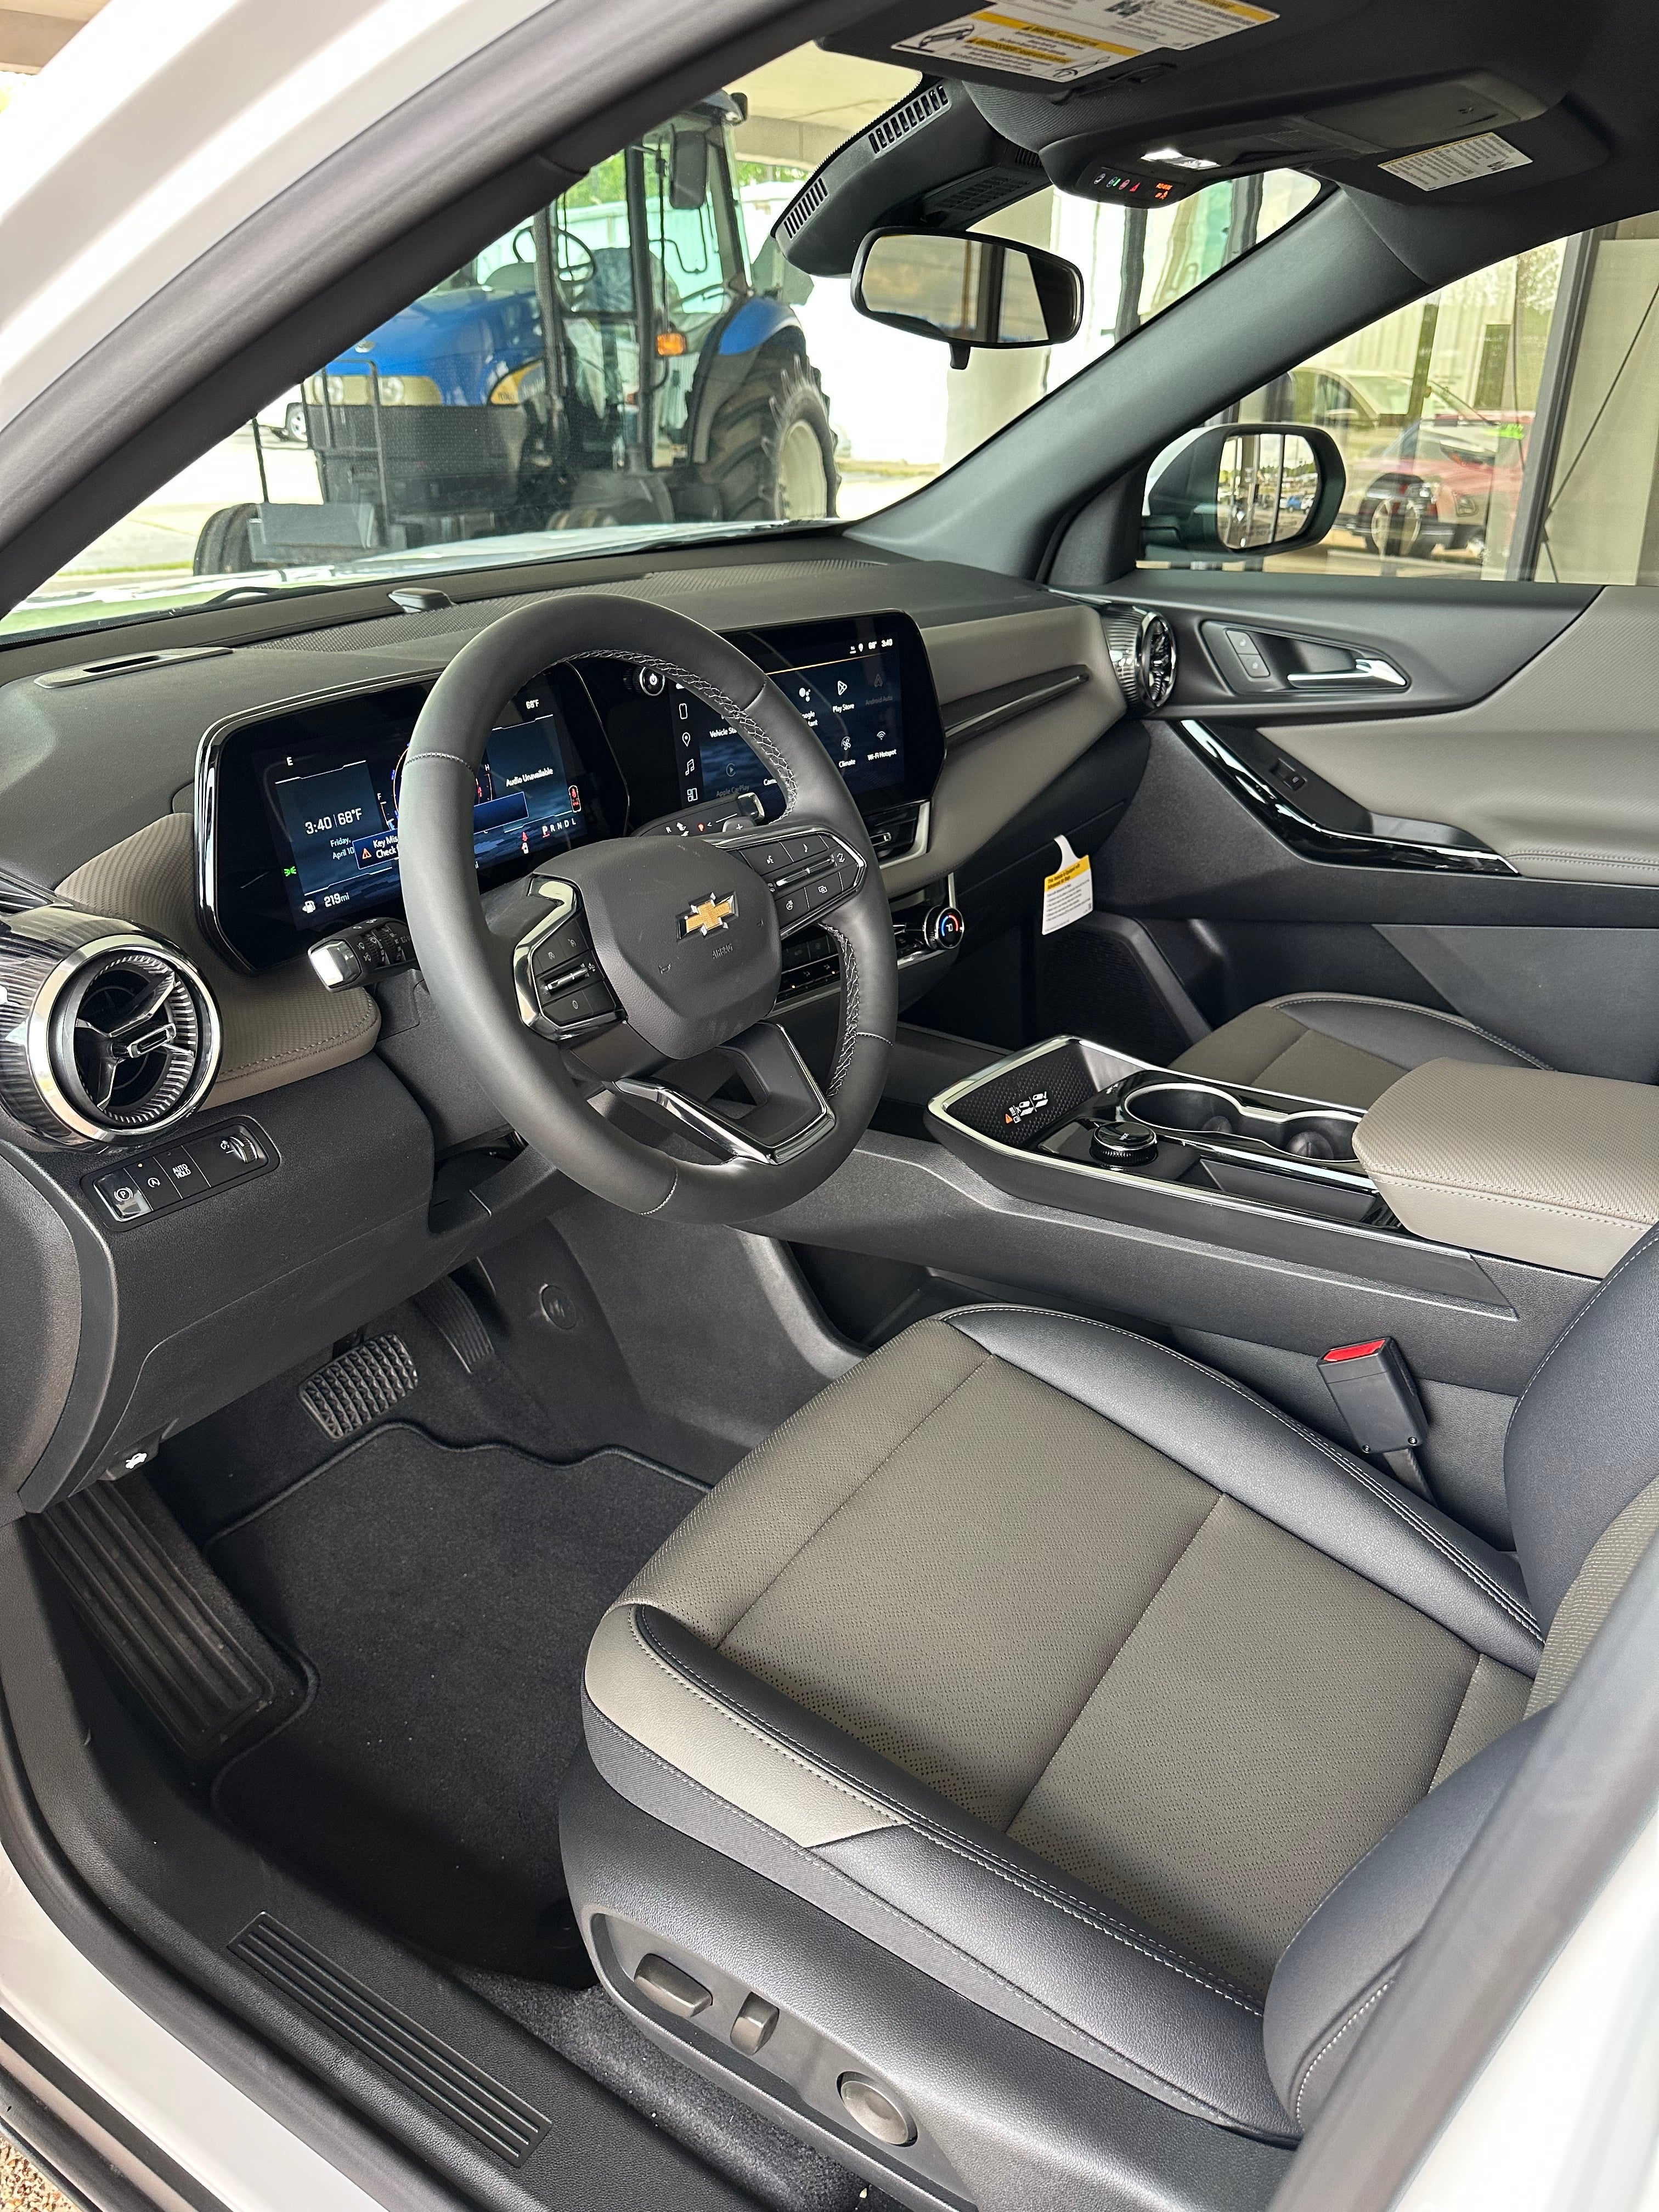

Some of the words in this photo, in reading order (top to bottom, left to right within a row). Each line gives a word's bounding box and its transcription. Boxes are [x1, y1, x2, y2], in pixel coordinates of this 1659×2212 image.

[881, 639, 893, 647] 3:40
[865, 697, 882, 706] Android
[832, 704, 842, 713] Play
[709, 728, 728, 738] Vehicle
[867, 752, 879, 761] Wi-Fi
[879, 749, 897, 758] Hotspot
[286, 757, 294, 766] E
[838, 759, 856, 768] Climate
[506, 776, 523, 787] Audio
[522, 767, 554, 782] Unavailable
[716, 787, 731, 797] Apple
[731, 785, 750, 793] CarPlay
[305, 816, 332, 835] 3:40
[337, 808, 363, 825] 68°F
[330, 837, 351, 848] Friday,
[373, 839, 385, 849] Key
[385, 835, 398, 845] Mis
[332, 848, 347, 860] April
[347, 847, 355, 855] 10
[376, 847, 397, 859] Check
[712, 943, 733, 960] AIRBAG
[172, 1163, 188, 1174] AUTO
[175, 1169, 191, 1179] HOLD
